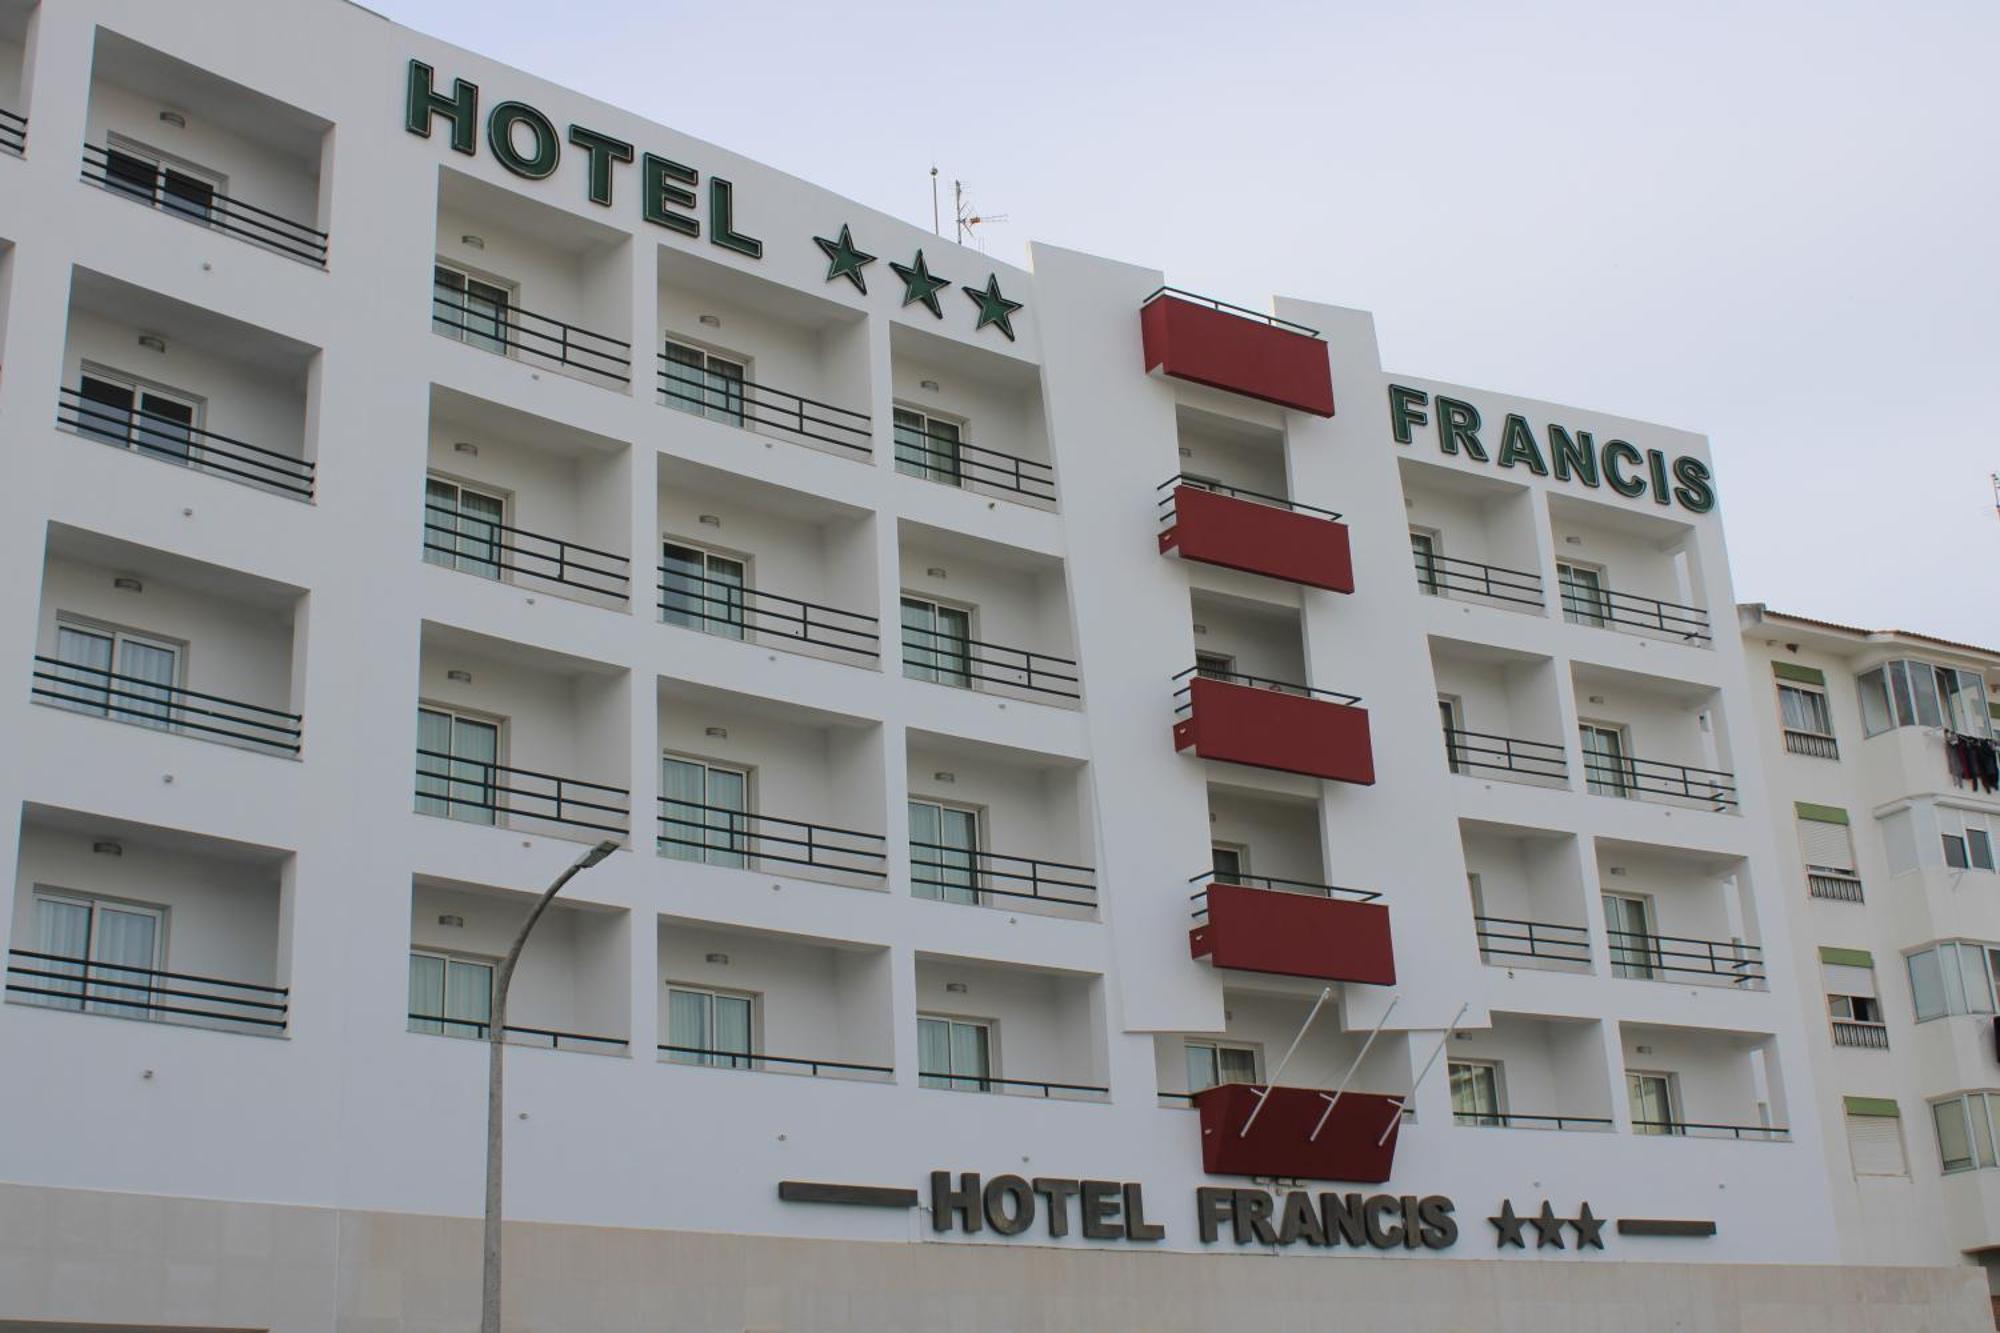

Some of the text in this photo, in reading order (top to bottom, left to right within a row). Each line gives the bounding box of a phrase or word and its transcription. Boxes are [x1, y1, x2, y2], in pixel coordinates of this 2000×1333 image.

[406, 58, 763, 259] HOTEL
[1388, 383, 1716, 514] FRANCIS
[931, 1170, 1458, 1250] HOTEL FRANCIS
